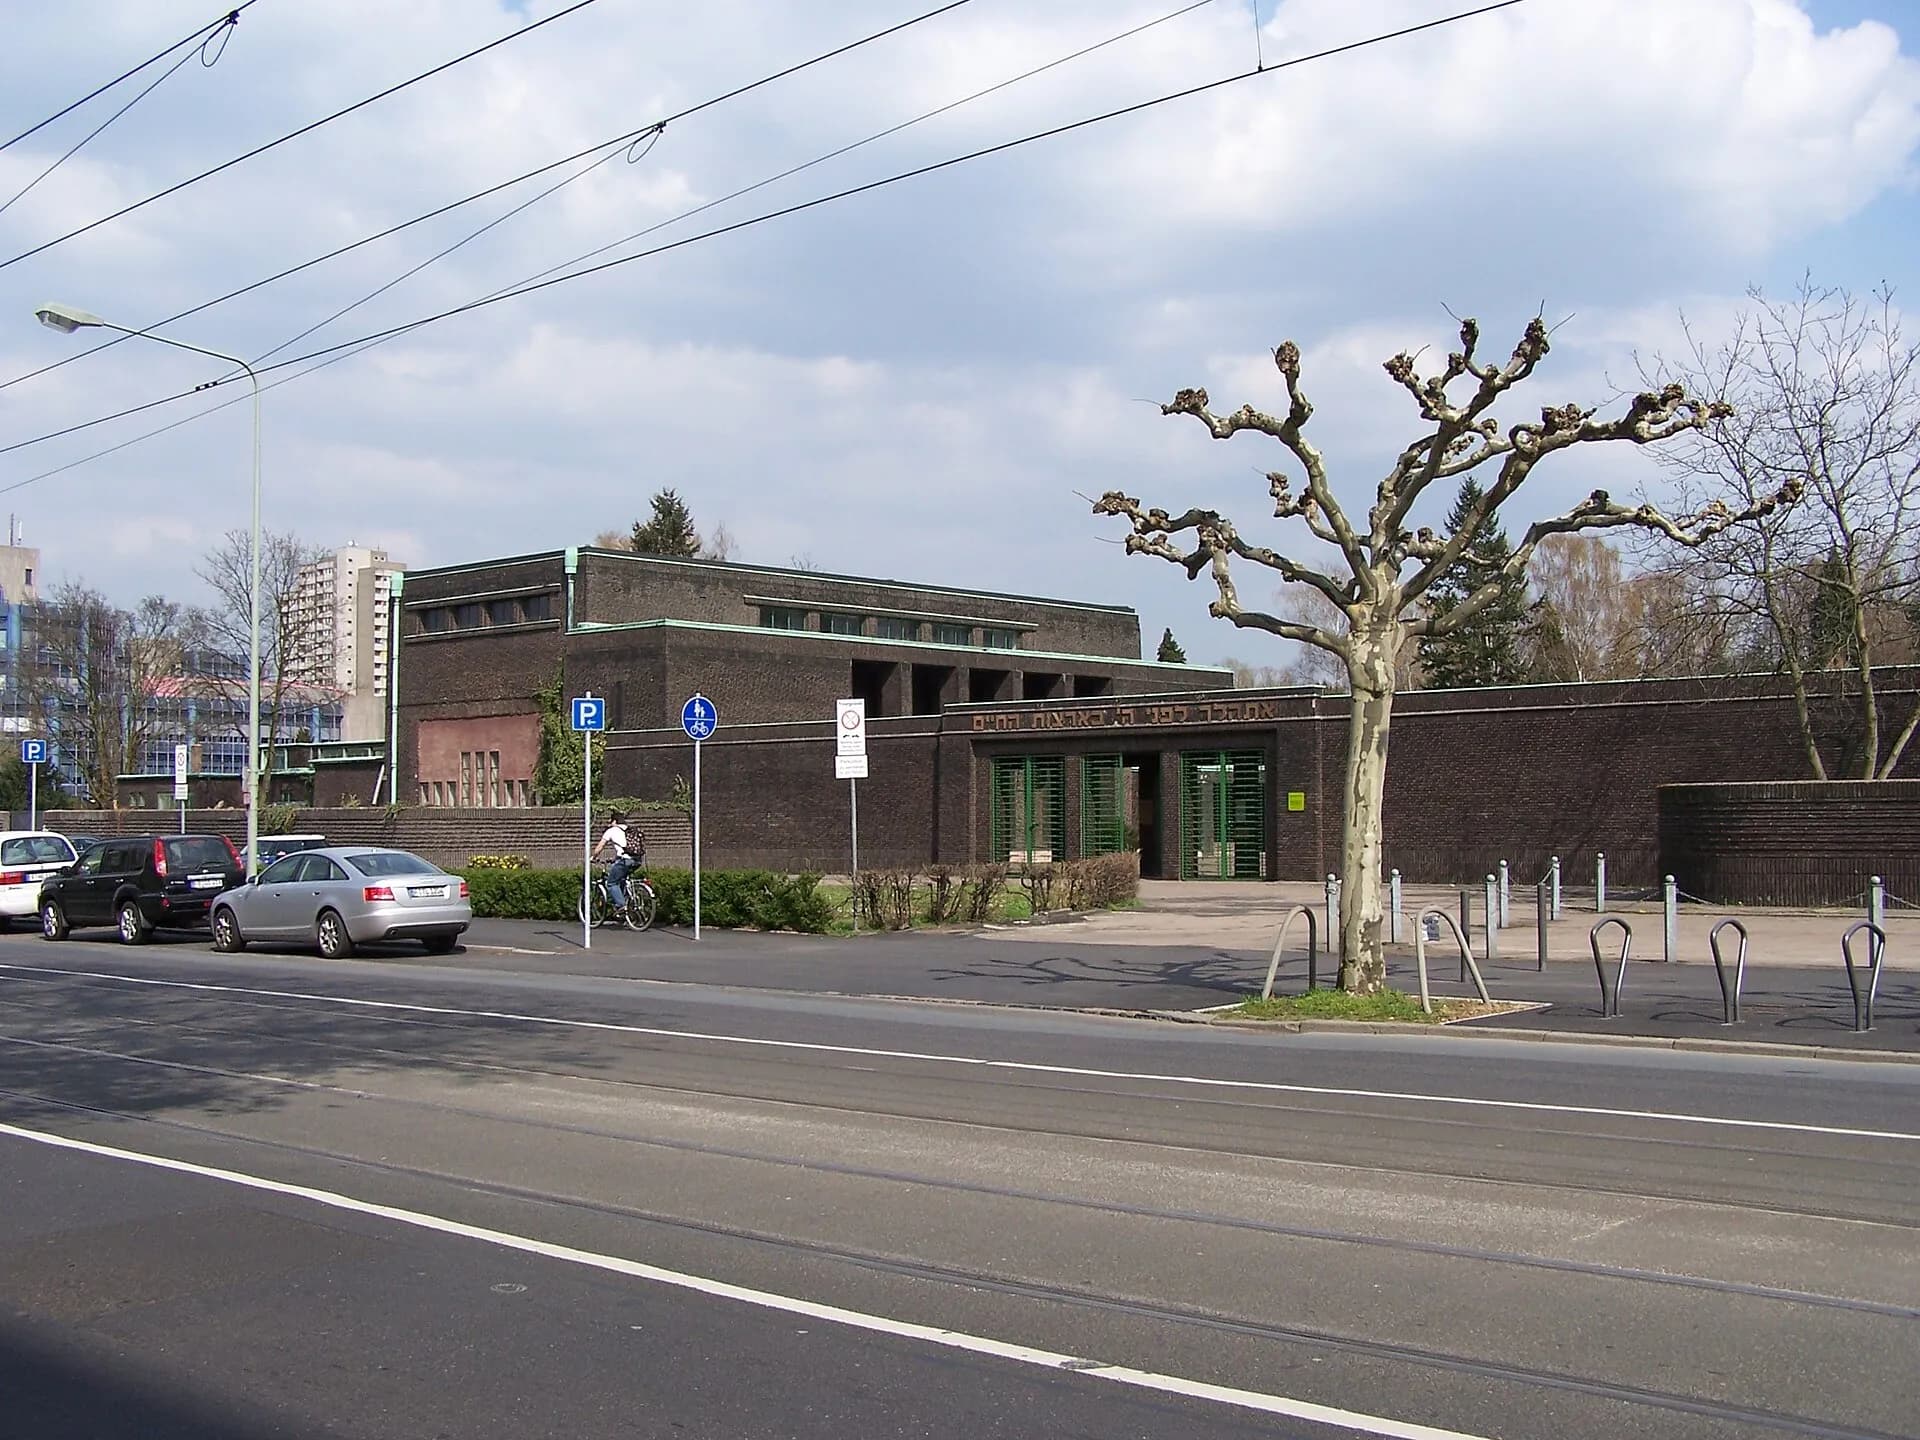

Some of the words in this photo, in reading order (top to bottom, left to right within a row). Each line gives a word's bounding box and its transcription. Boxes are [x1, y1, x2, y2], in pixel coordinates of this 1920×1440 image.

[580, 703, 597, 726] P
[1145, 705, 1187, 723] לפני
[1199, 702, 1274, 721] אתהלך
[972, 712, 1019, 730] החיים
[28, 743, 41, 759] P
